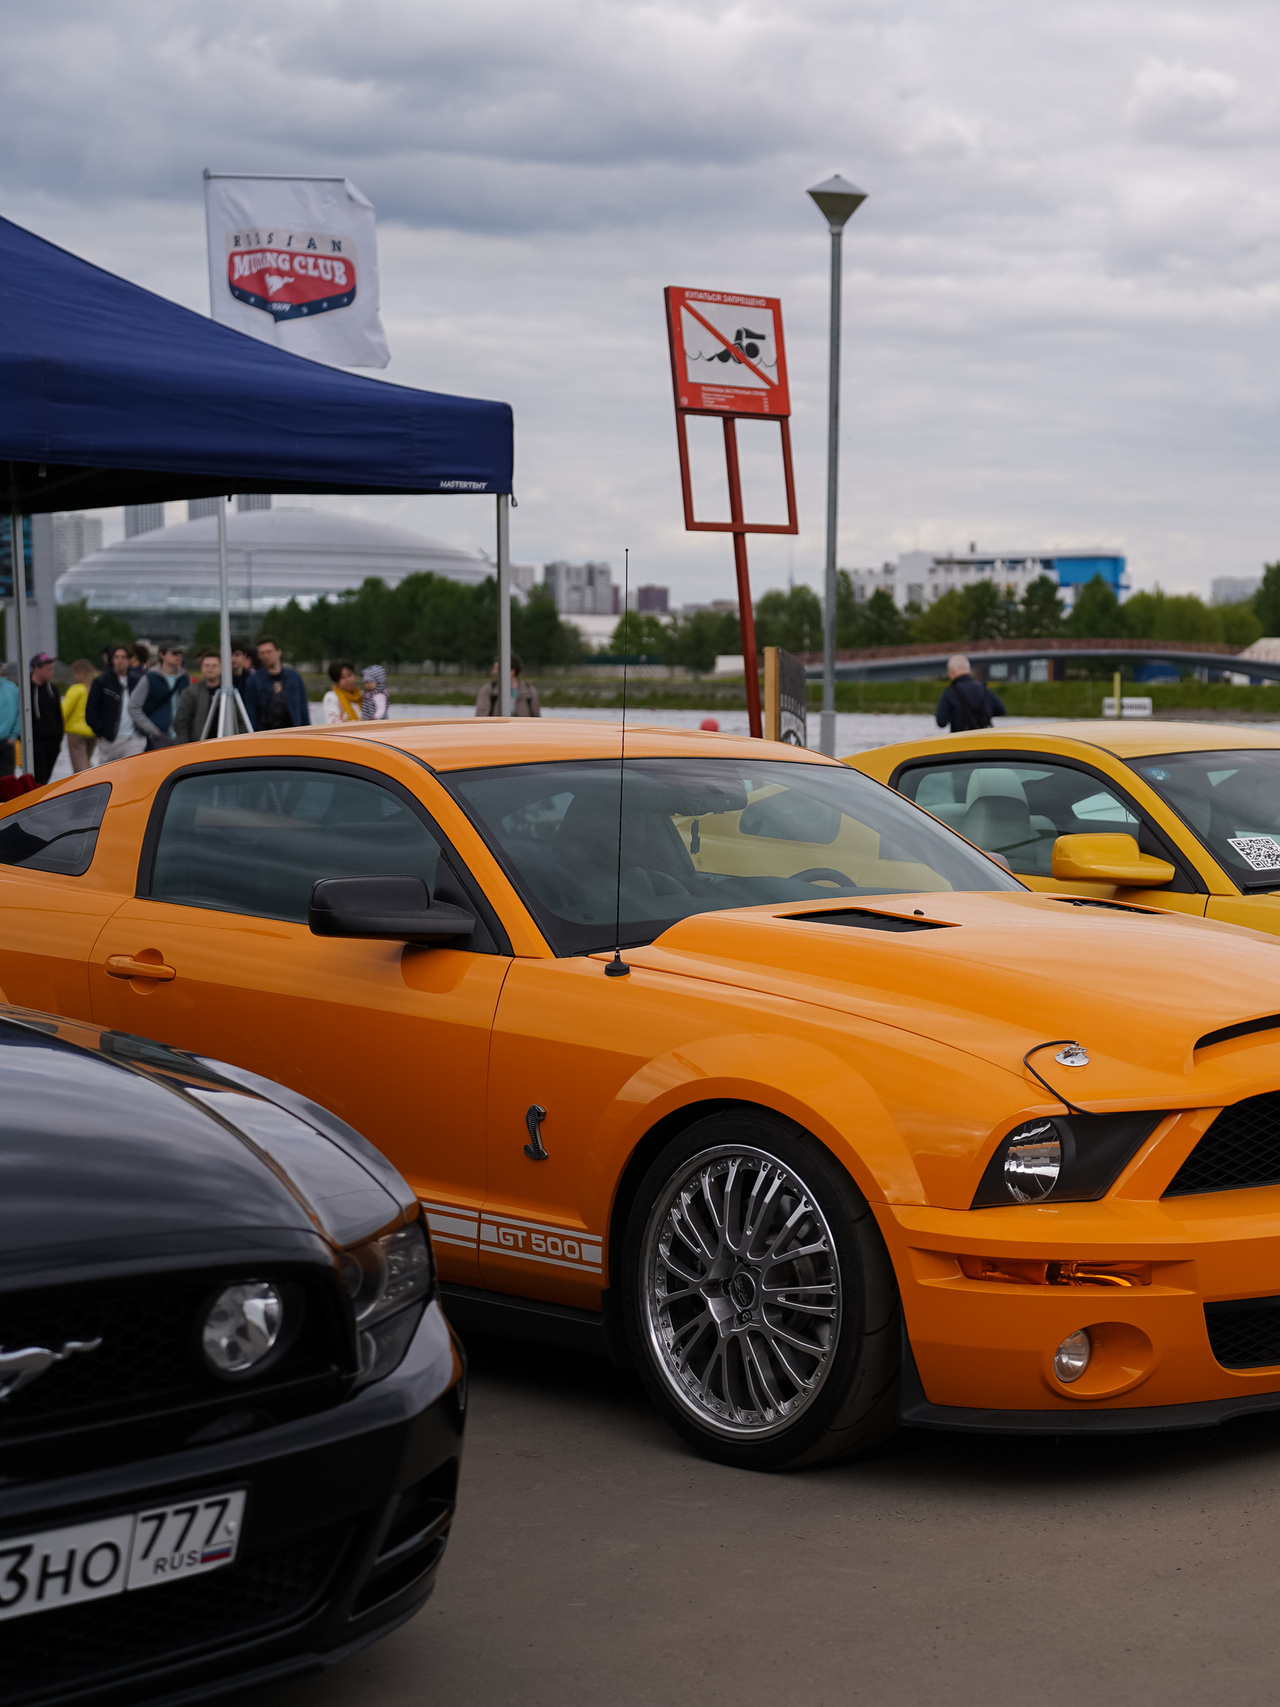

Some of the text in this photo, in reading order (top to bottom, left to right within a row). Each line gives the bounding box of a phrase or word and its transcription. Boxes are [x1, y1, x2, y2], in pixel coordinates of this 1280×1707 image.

[293, 255, 348, 286] CLUB
[684, 290, 767, 307] КУПАТЬСЯ ЗАПРЕЩЕНО
[440, 480, 488, 490] MASTERTENT
[499, 1227, 580, 1260] GT 500
[140, 1497, 232, 1561] 777
[153, 1549, 200, 1575] RUS
